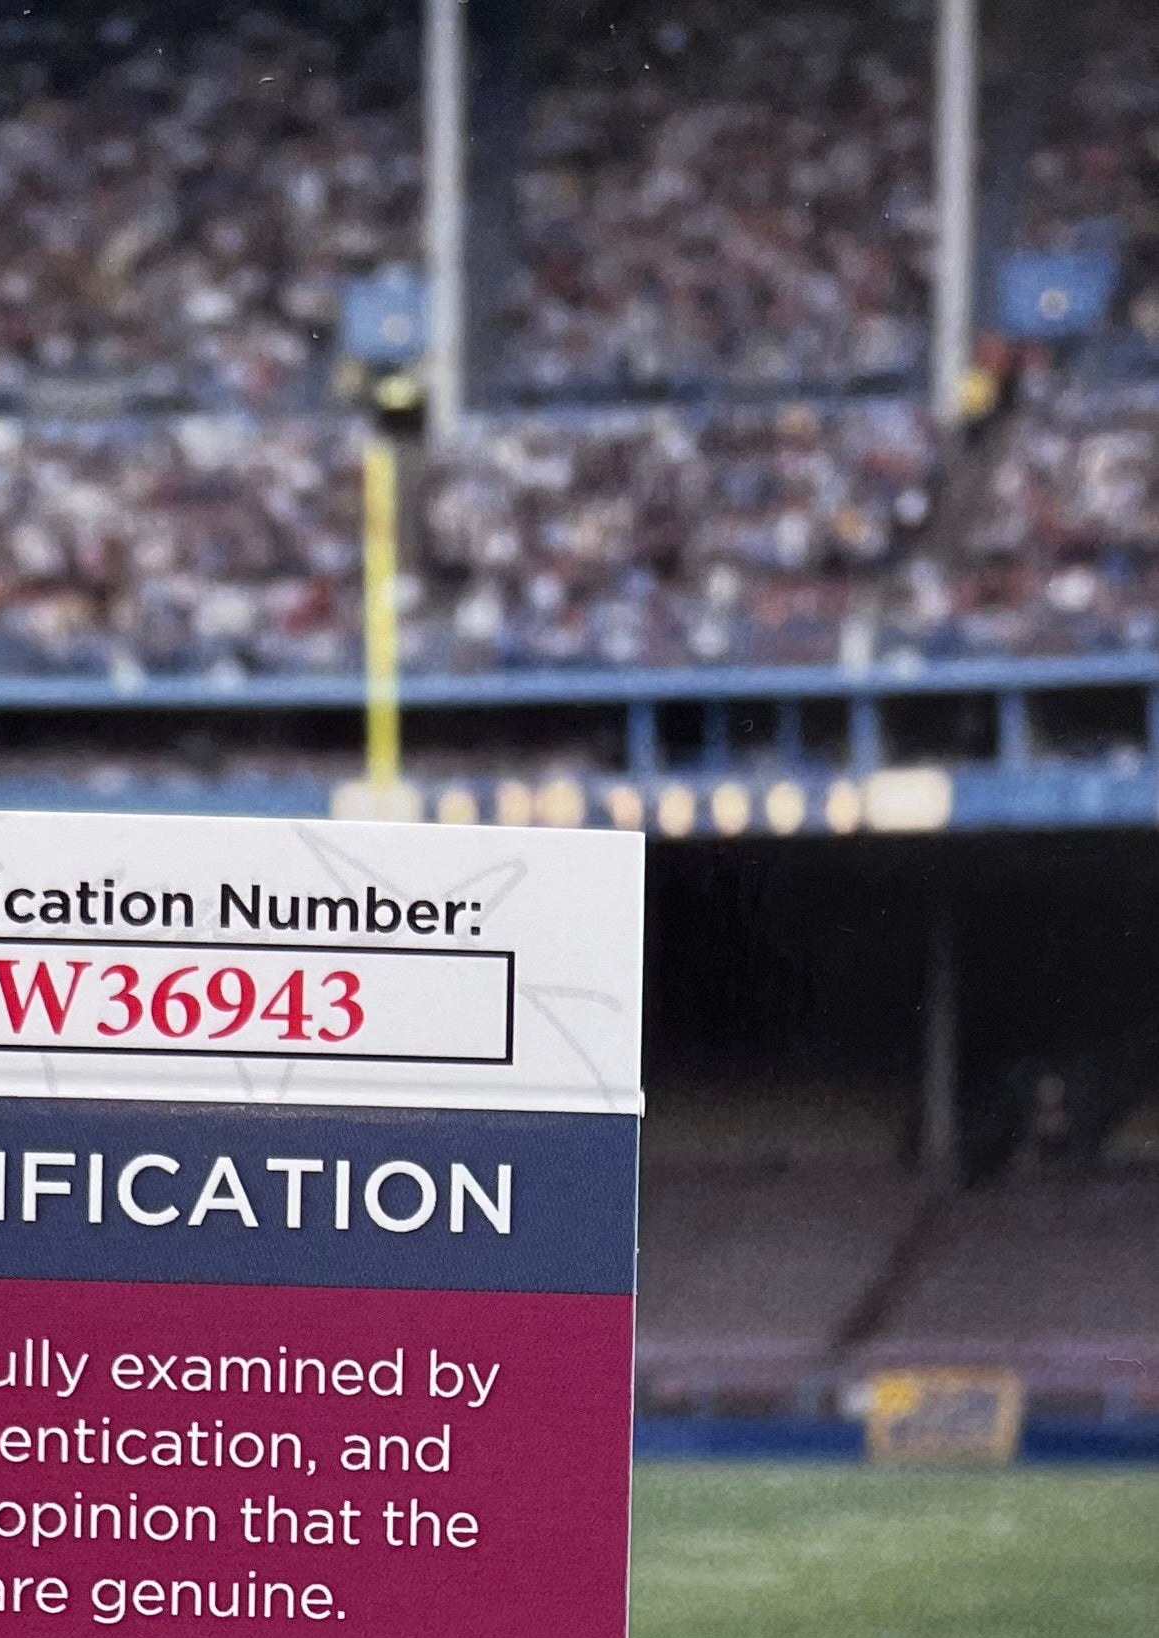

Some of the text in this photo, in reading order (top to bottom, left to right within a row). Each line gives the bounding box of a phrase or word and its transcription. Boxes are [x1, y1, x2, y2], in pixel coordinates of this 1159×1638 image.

[220, 883, 482, 935] Number:
[111, 1345, 404, 1397] examined
[429, 1348, 500, 1408] by
[340, 1424, 450, 1473] and
[240, 1495, 362, 1545] that
[382, 1498, 479, 1548] the
[91, 1570, 346, 1625] genuine.
